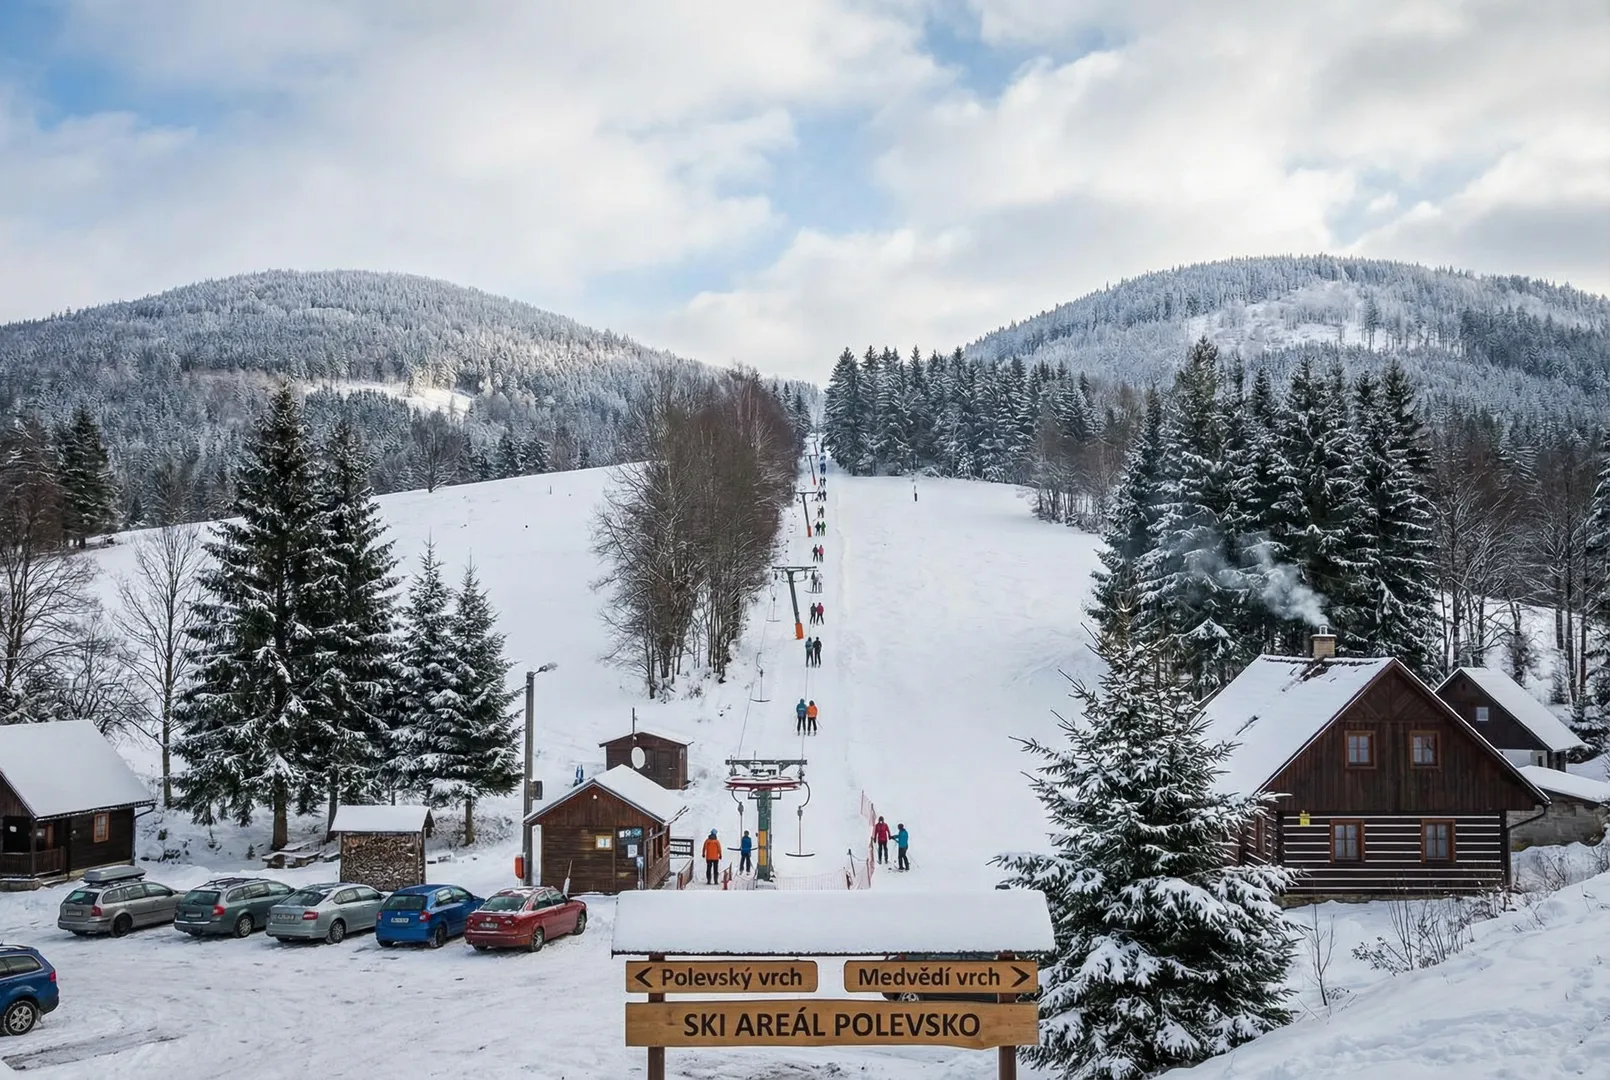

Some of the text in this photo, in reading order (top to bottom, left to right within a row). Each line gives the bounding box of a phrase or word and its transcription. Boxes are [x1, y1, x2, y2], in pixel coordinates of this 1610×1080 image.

[661, 967, 803, 990] Polevský vrch
[858, 967, 1000, 986] Medvědí vrch
[684, 1007, 981, 1037] SKI AREÁL POLEVSKO
